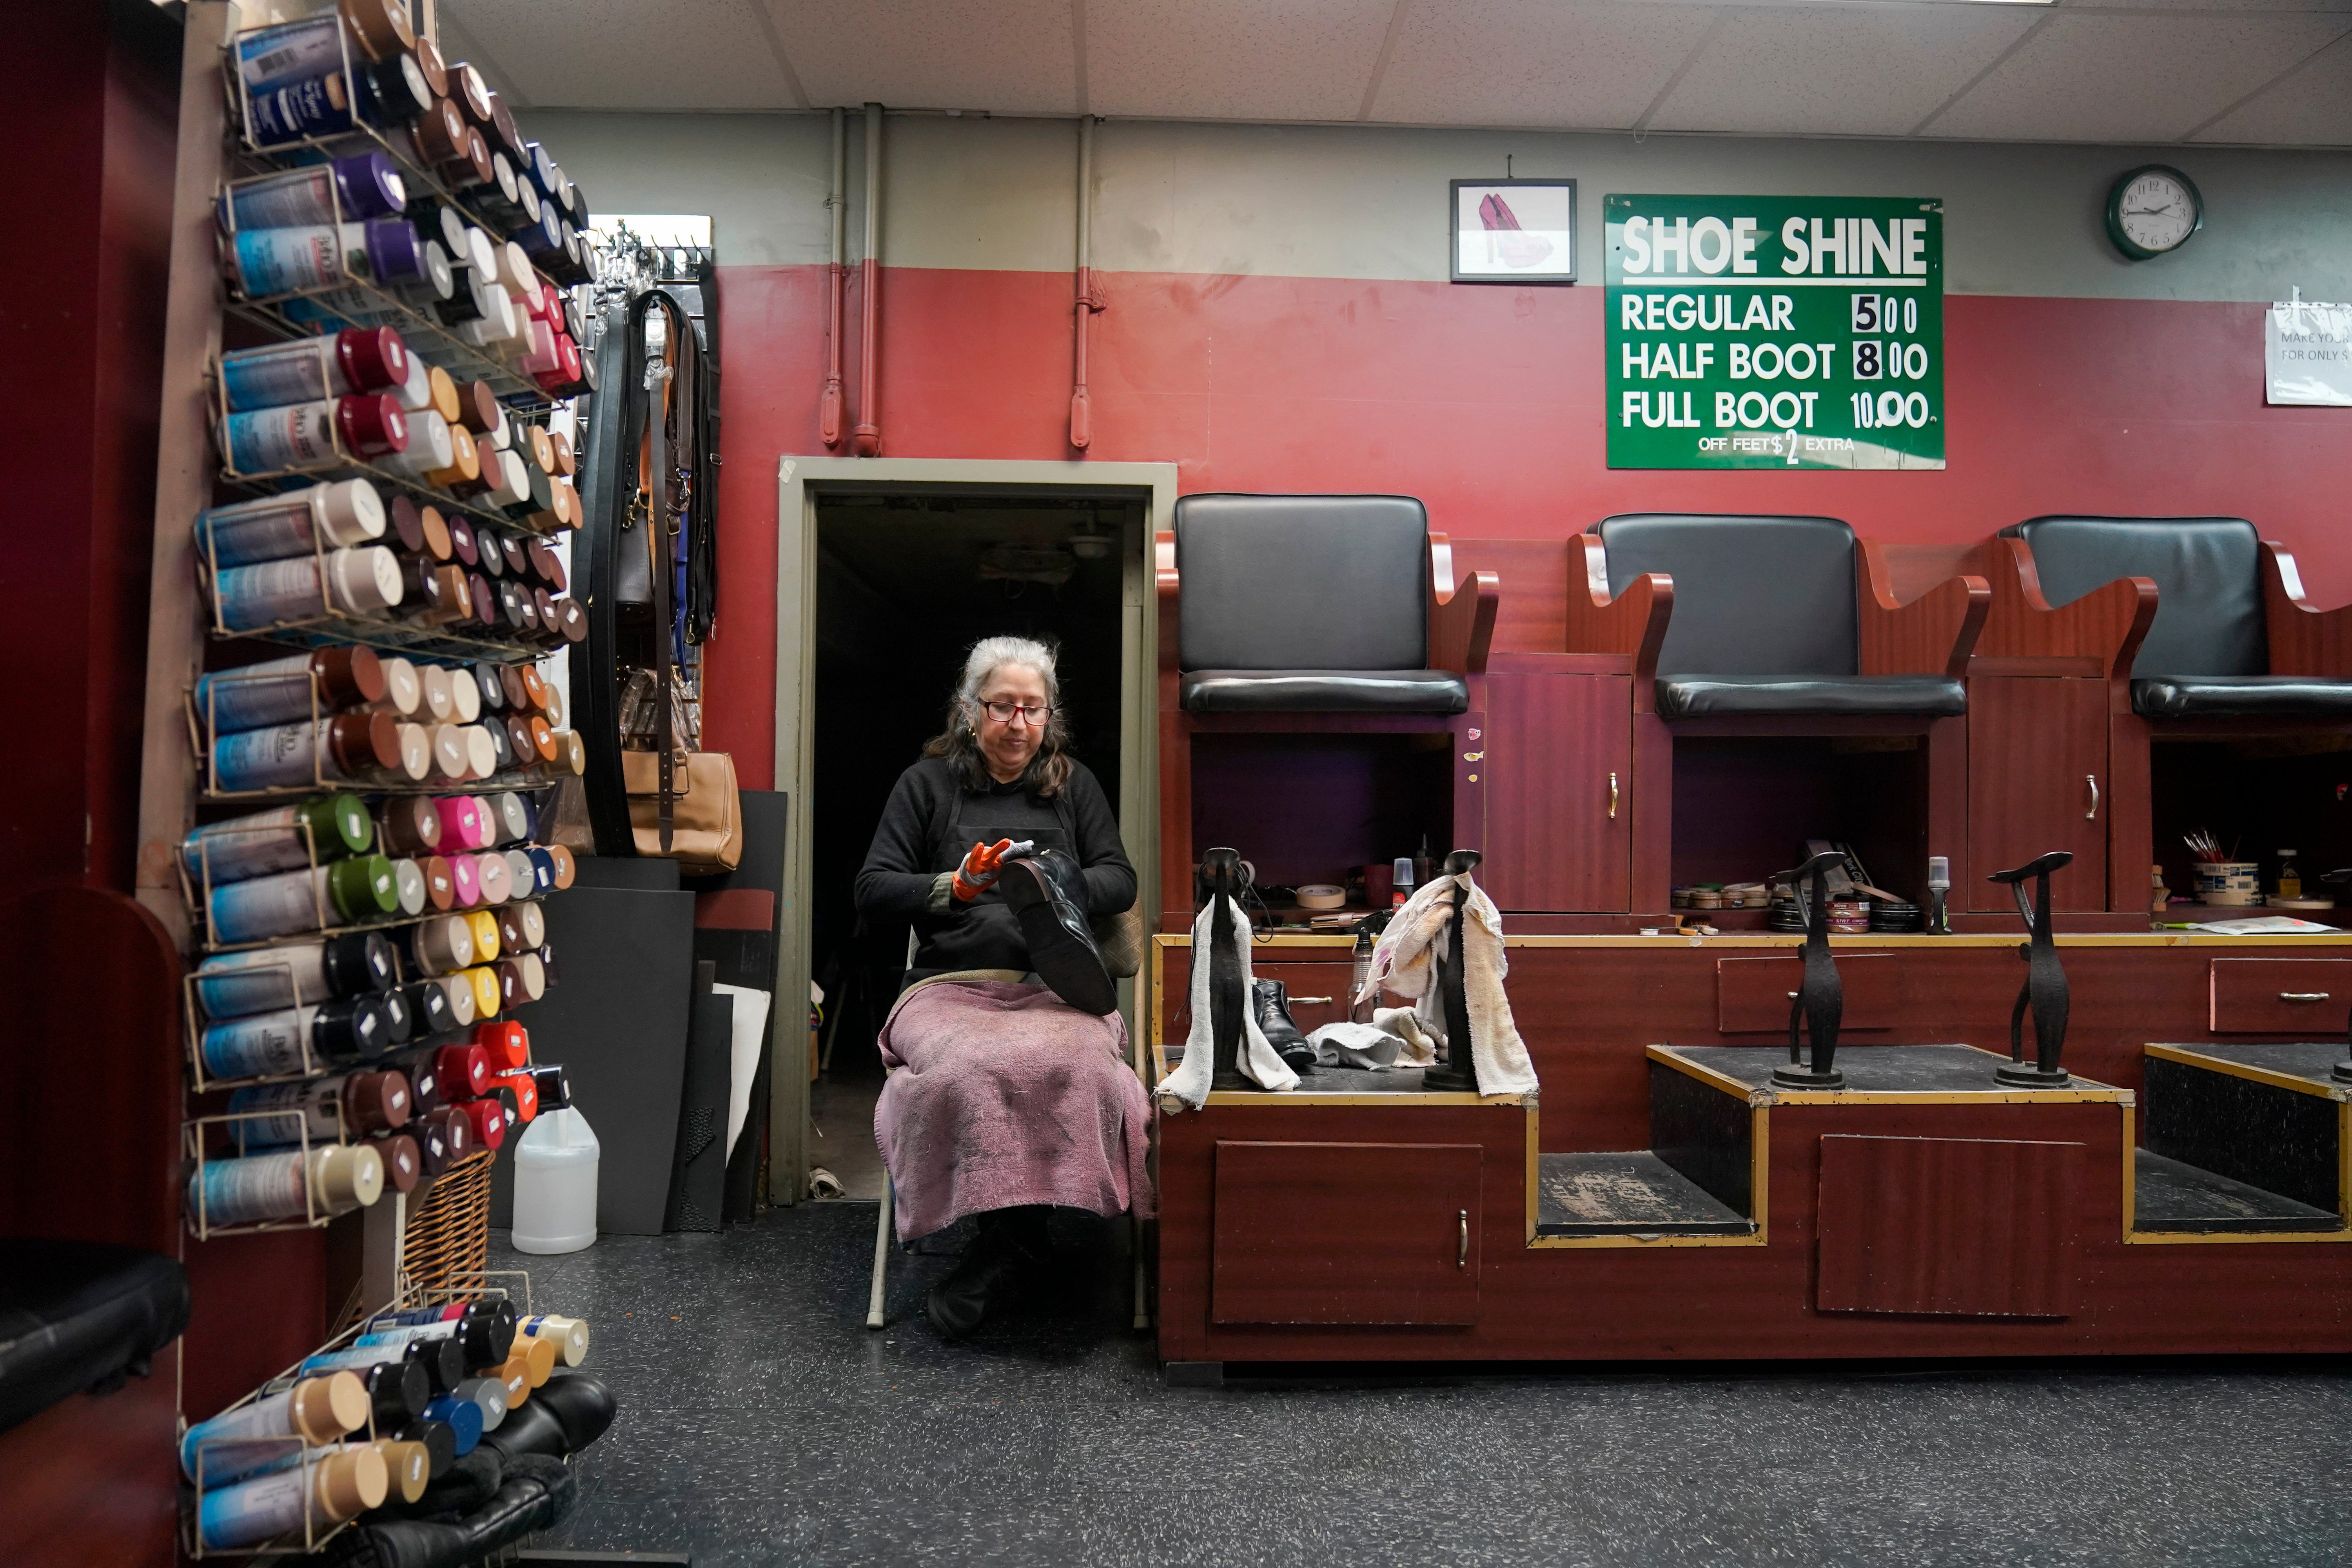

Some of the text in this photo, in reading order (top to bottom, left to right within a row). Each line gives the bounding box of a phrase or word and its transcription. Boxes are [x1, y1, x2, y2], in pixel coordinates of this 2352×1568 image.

[2138, 184, 2145, 194] 11
[2149, 180, 2160, 191] 12
[2166, 185, 2169, 194] 1
[2128, 195, 2137, 205] 10
[2174, 195, 2181, 205] 2
[2122, 208, 2129, 219] 9
[2179, 208, 2186, 218] 3
[2127, 223, 2133, 233] 8
[2140, 233, 2145, 243] 7
[2151, 236, 2158, 246] 6
[2163, 232, 2169, 244] 5
[1622, 216, 1927, 274] SHOE SHINE
[1622, 294, 1795, 330] REGULAR
[2281, 333, 2314, 343] MAKE
[2282, 350, 2304, 360] FOR
[2308, 350, 2338, 360] ONLY
[1622, 343, 1714, 379] HALF
[1730, 343, 1835, 379] BOOT
[1623, 392, 1700, 428] FULL
[1716, 391, 1818, 428] BOOT
[1699, 437, 1727, 451] OFF
[1733, 437, 1770, 450] FEET
[1806, 438, 1855, 450] EXTRA
